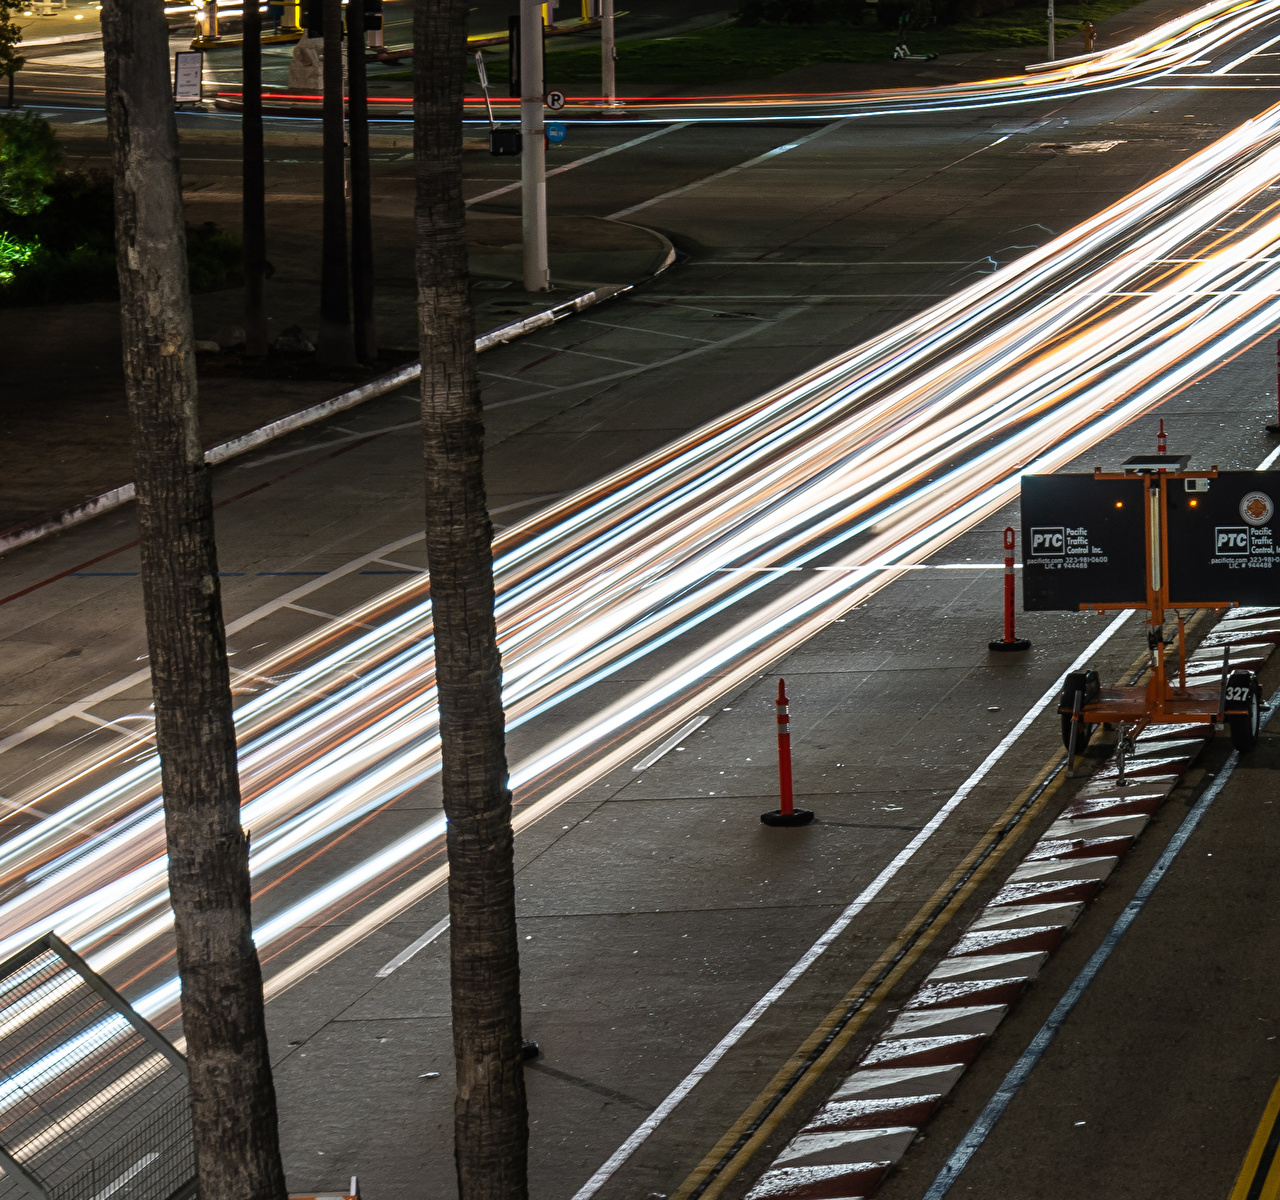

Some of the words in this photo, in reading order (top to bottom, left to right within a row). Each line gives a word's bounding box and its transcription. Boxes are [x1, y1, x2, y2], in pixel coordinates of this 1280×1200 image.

[1066, 527, 1088, 536] Pacific
[1250, 527, 1273, 535] Pacific
[1033, 533, 1063, 548] PTC
[1067, 537, 1089, 545] Traffic
[1217, 533, 1248, 547] PTC
[1251, 536, 1273, 545] Traffic
[1067, 546, 1089, 554] Control
[1091, 546, 1104, 554] Inc.
[1251, 545, 1275, 554] Control,
[1065, 556, 1108, 564] 323-981-0600
[1225, 686, 1250, 702] 327
